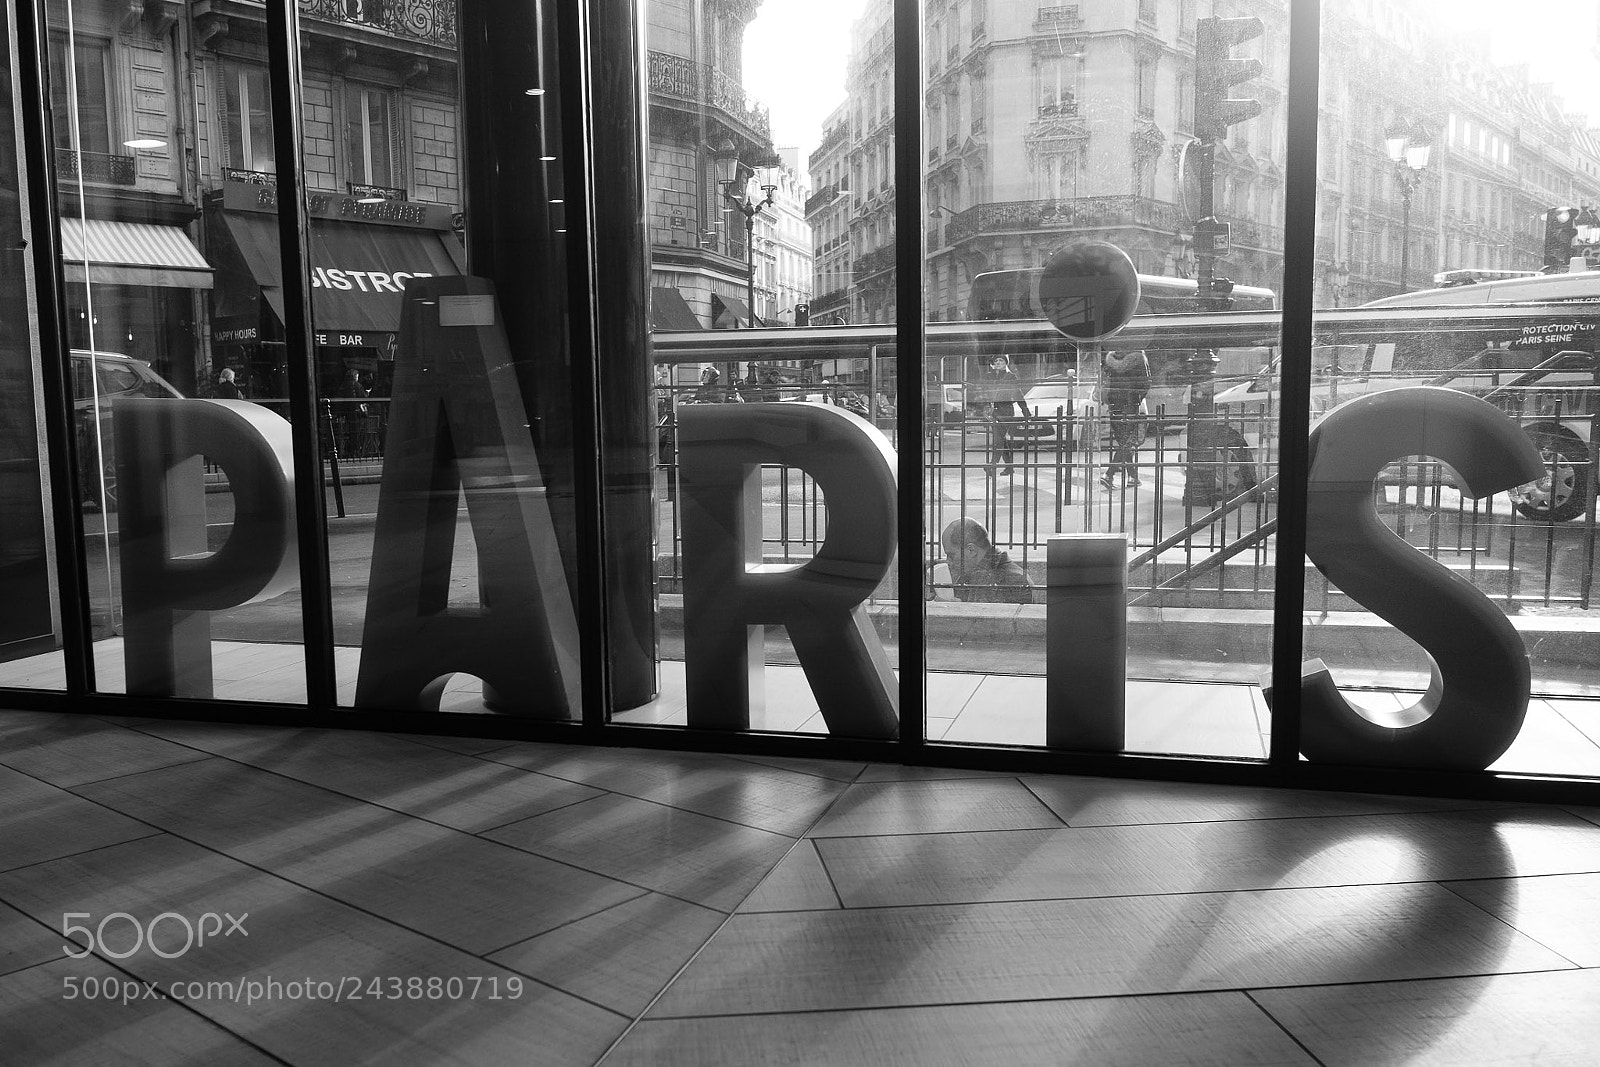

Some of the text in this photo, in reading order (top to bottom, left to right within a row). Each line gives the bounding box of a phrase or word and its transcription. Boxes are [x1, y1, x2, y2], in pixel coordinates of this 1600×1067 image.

[311, 266, 433, 293] ISTRO
[214, 327, 257, 342] HAPPY HOURS
[1521, 324, 1577, 335] ROTECTION
[339, 334, 363, 346] BAR
[1544, 333, 1573, 343] SEINE
